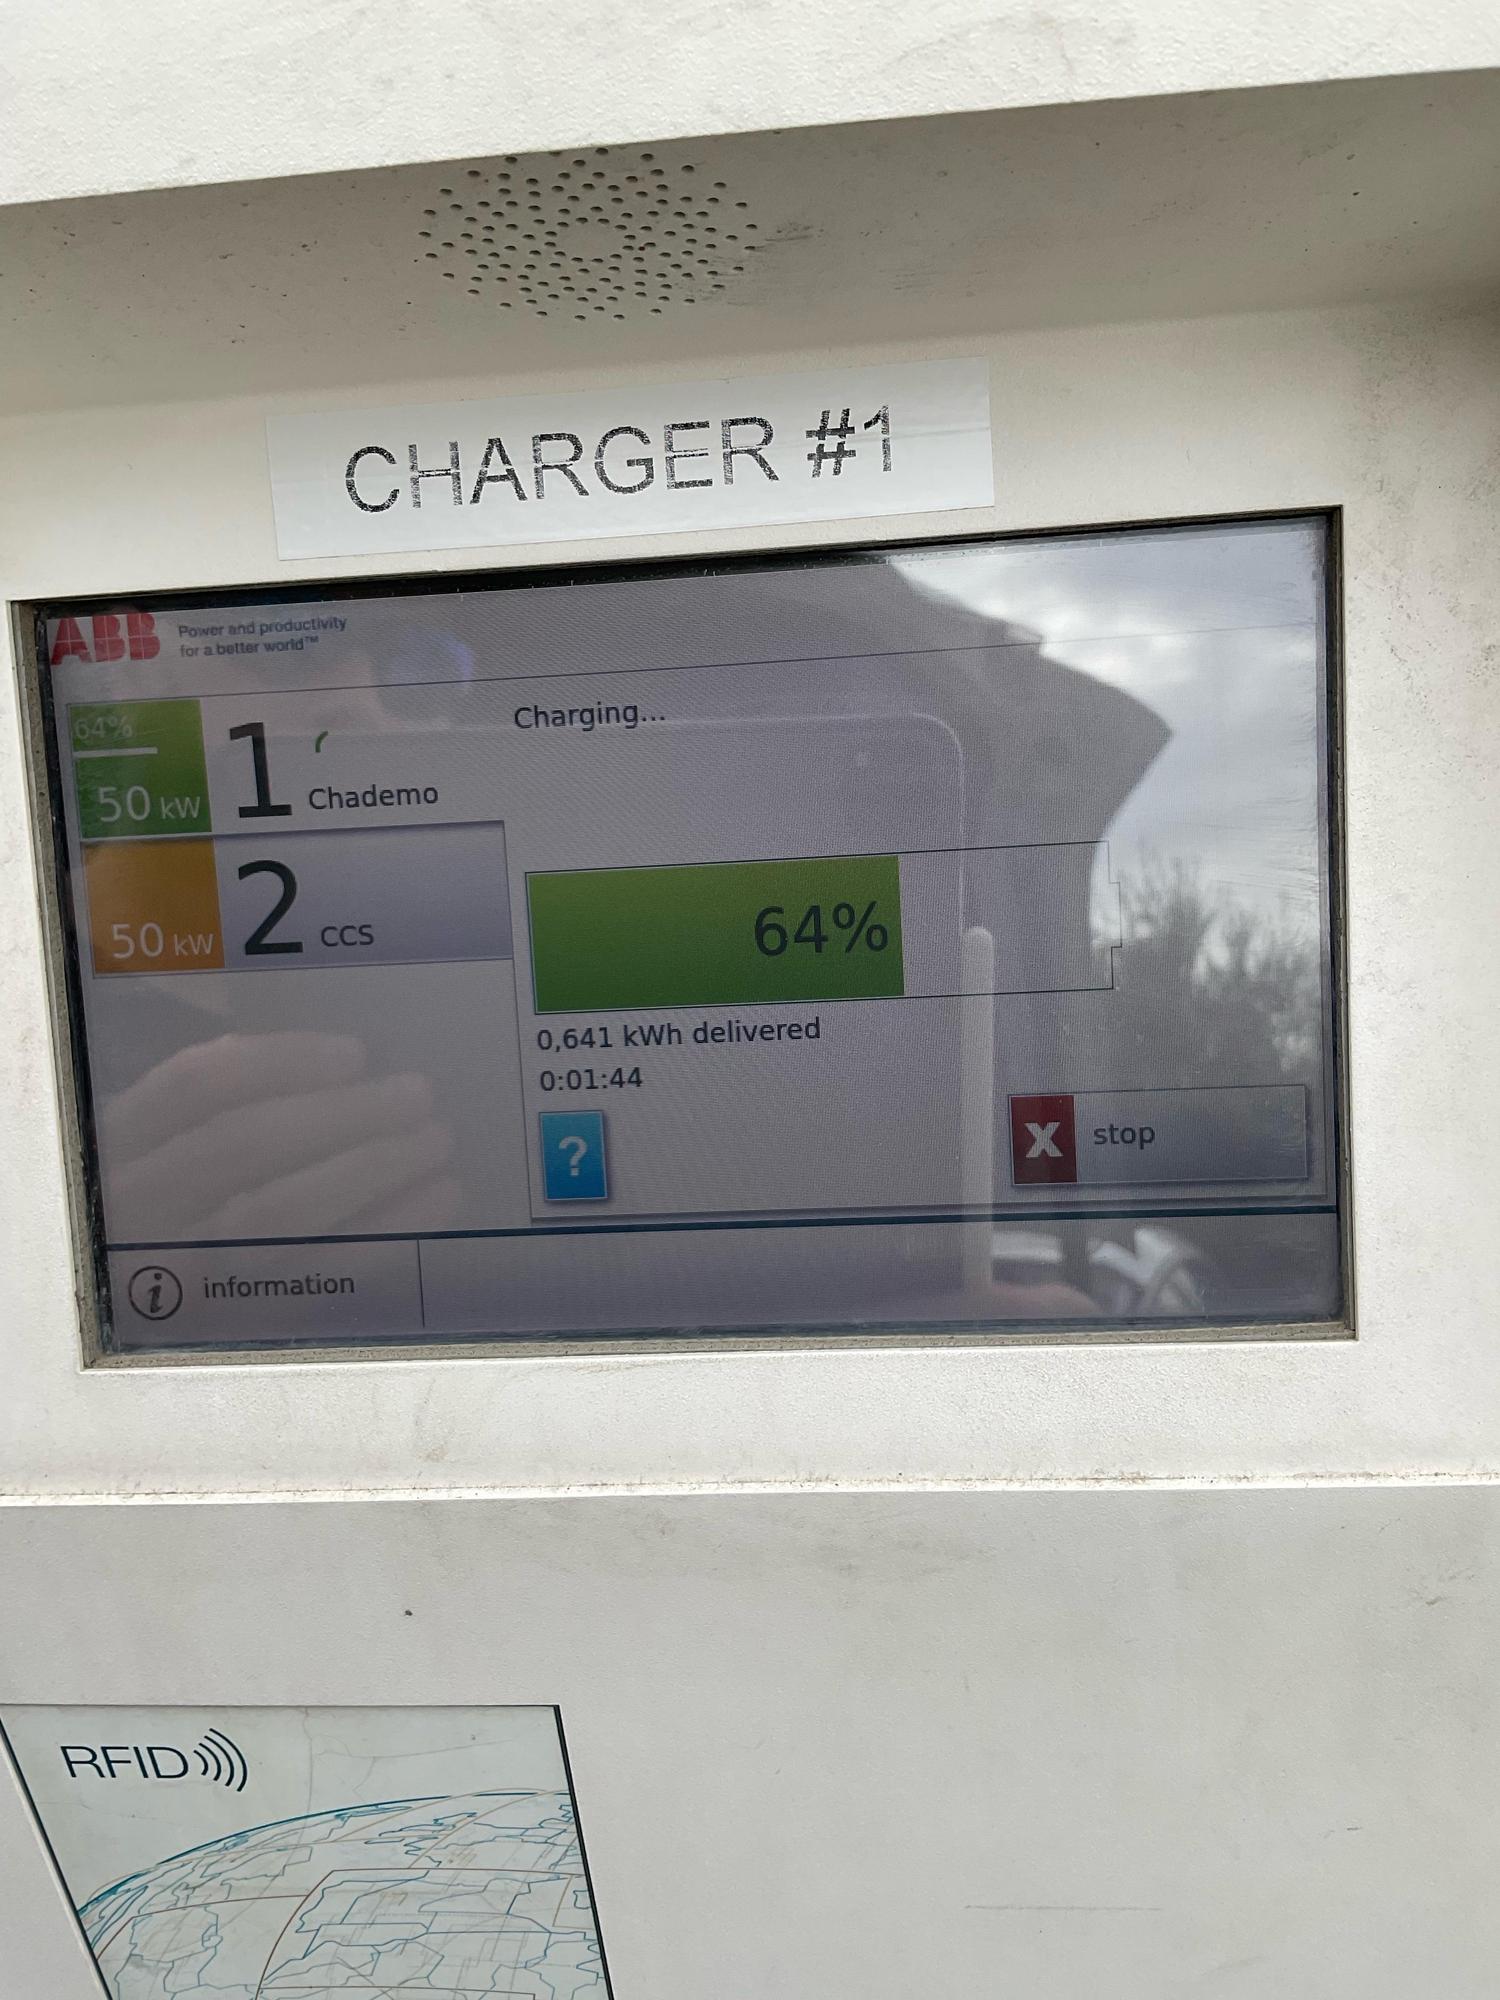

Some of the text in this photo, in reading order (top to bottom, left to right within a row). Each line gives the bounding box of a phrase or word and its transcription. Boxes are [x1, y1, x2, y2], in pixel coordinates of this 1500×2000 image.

[345, 404, 892, 513] CHARGER #1
[51, 611, 161, 665] ABB
[179, 616, 347, 639] Power and productivity
[180, 643, 200, 657] for
[203, 645, 214, 656] a
[216, 640, 258, 656] better
[74, 714, 134, 739] 64%
[514, 700, 666, 731] Charging...
[229, 722, 293, 818] 1
[98, 785, 201, 822] 50 kW
[309, 783, 438, 810] Chademo
[237, 860, 303, 956] 2
[111, 922, 214, 960] 50 kW
[320, 924, 374, 947] CCS
[754, 900, 889, 956] 64%
[537, 1016, 820, 1052] 0,641 kWh delivered
[540, 1067, 643, 1091] 0:01:44
[1093, 1122, 1156, 1150] stop
[203, 1272, 355, 1299] information
[60, 1745, 190, 1781] RFID
